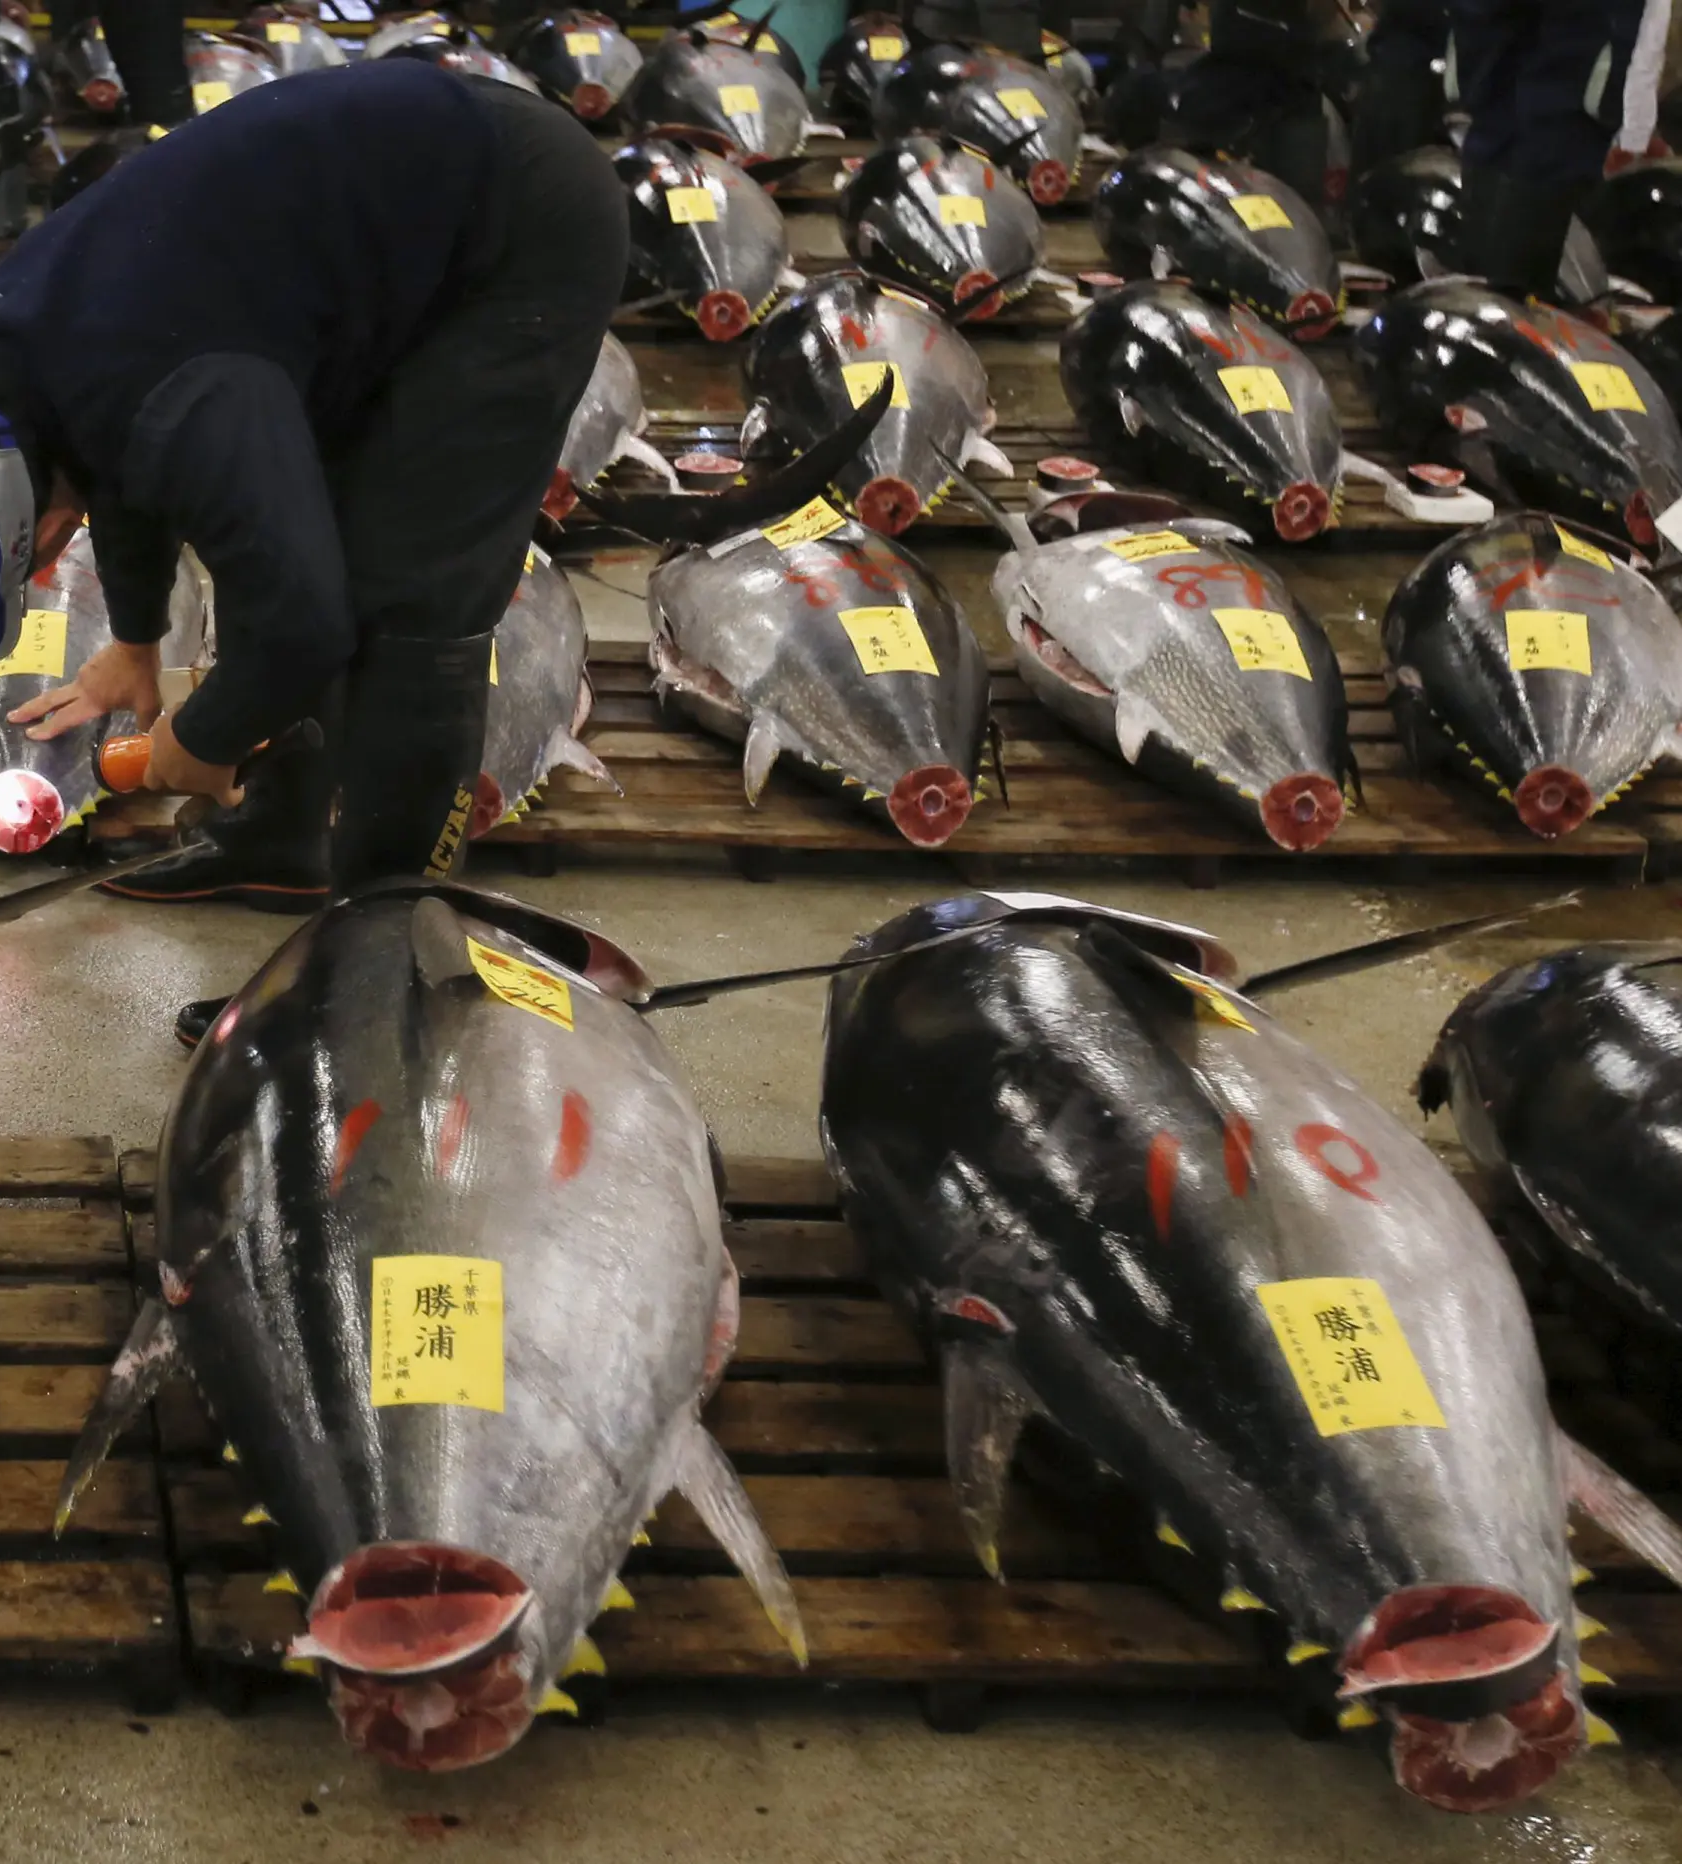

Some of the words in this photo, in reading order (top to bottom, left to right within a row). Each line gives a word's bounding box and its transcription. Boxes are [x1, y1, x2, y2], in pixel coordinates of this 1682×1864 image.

[330, 1087, 594, 1198] 111
[412, 1283, 461, 1361] 勝浦
[1313, 1305, 1383, 1384] 勝浦
